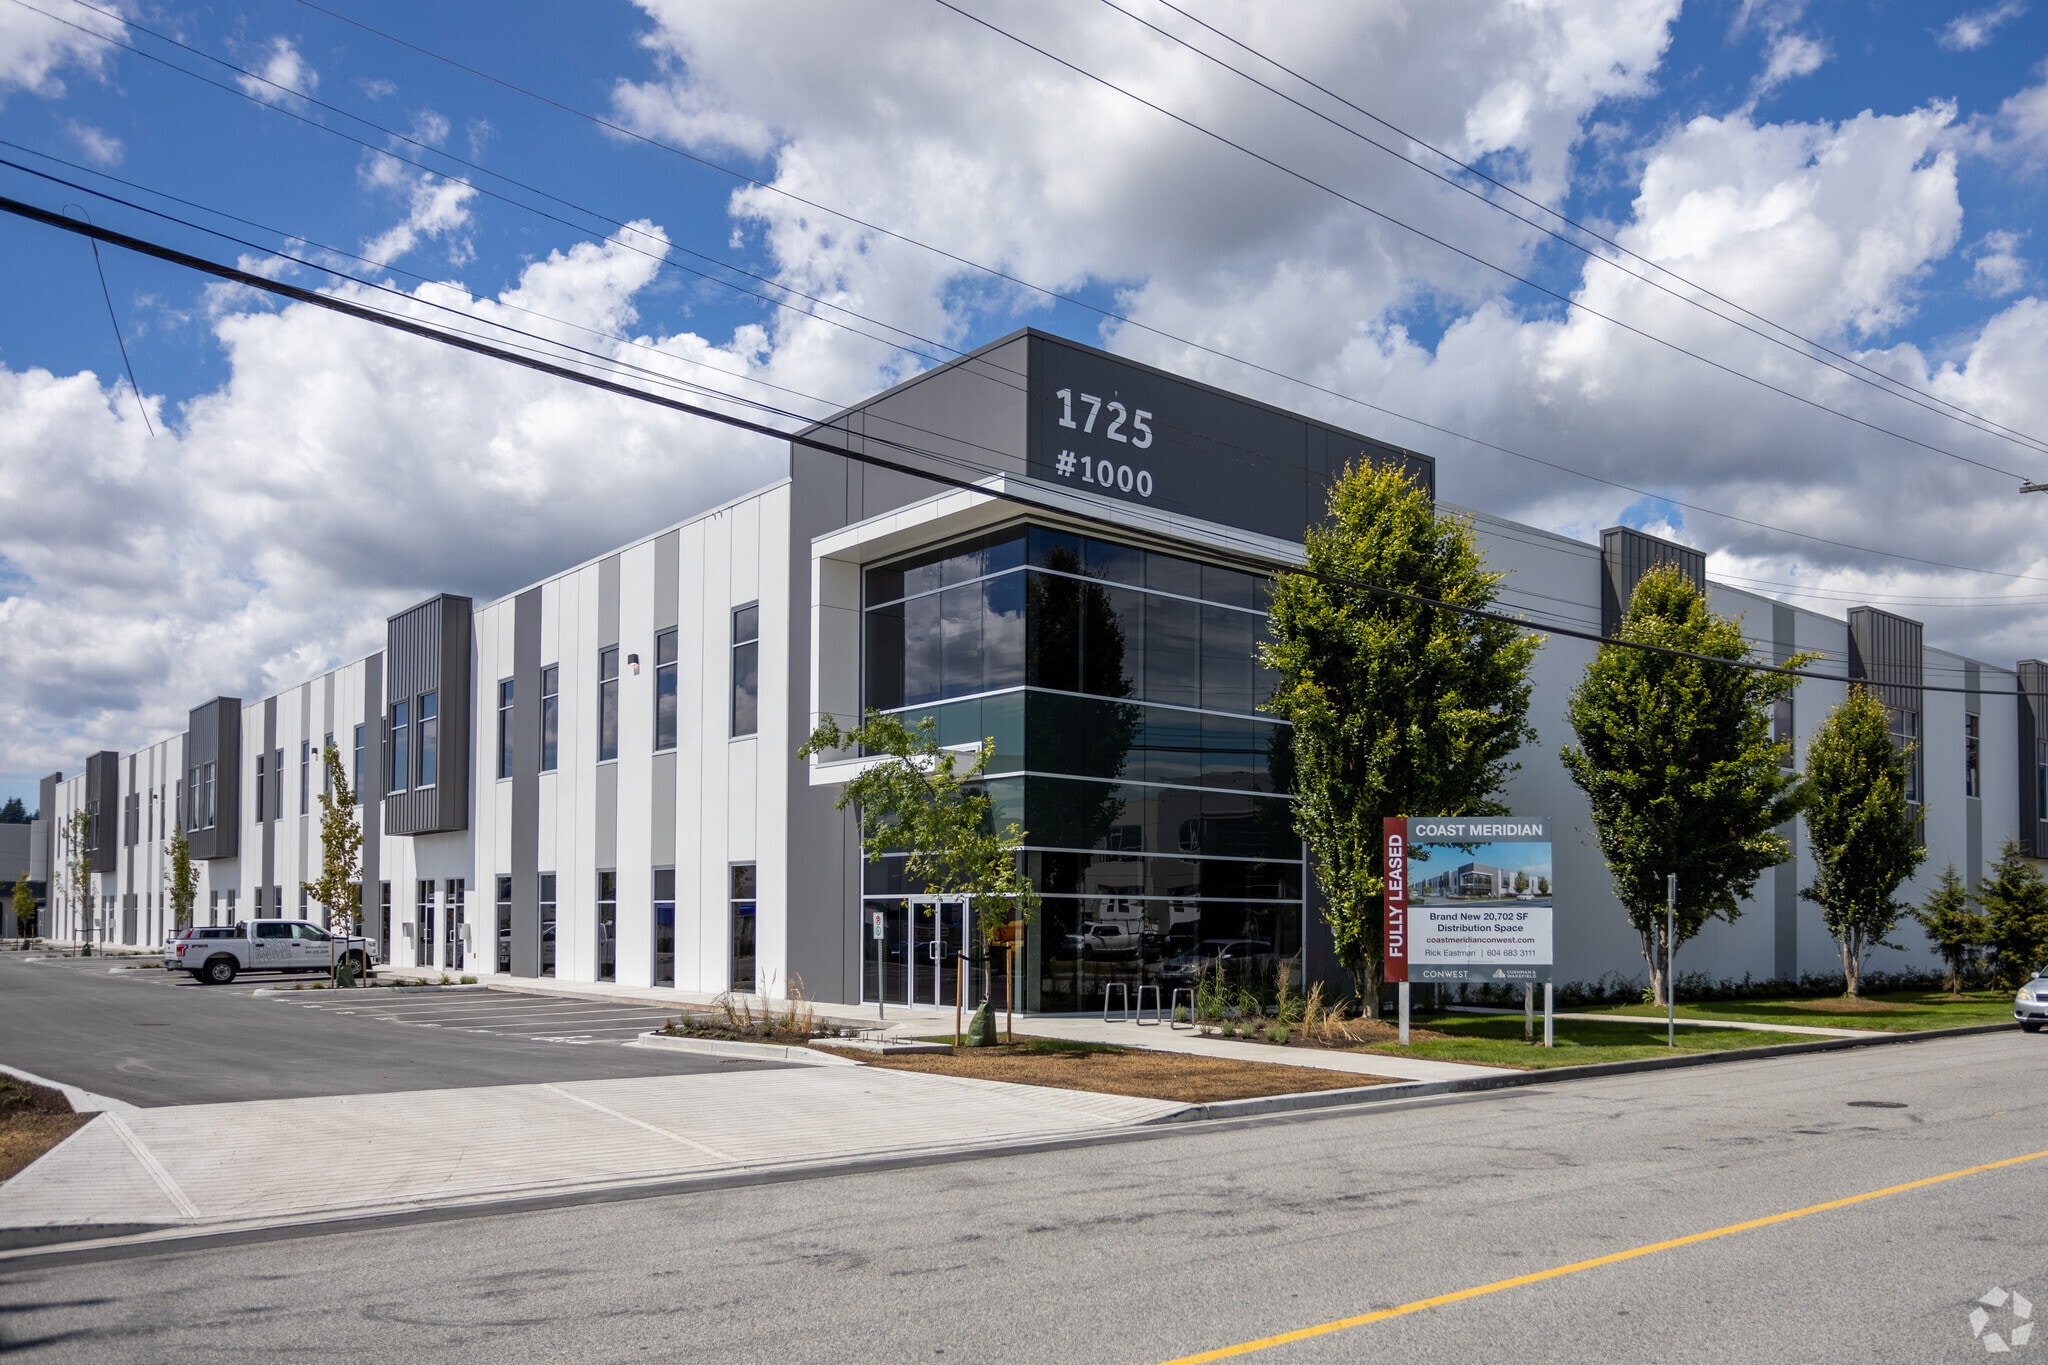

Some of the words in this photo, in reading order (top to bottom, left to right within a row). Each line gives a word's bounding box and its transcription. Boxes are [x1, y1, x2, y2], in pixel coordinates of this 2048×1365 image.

[1056, 388, 1153, 449] 1725
[1055, 449, 1153, 498] #1000
[1415, 824, 1466, 836] COAST
[1469, 824, 1543, 836] MERIDIAN
[1388, 834, 1403, 901] LEASED
[1429, 912, 1458, 921] Brand
[1460, 912, 1481, 921] New
[1483, 912, 1514, 921] 20,702
[1516, 912, 1529, 921] SF
[1388, 905, 1403, 957] FULLY
[1437, 923, 1492, 932] Distribution
[1493, 923, 1524, 933] Space
[1426, 936, 1535, 944] coastmeridianconwest.com
[1424, 949, 1442, 957] Rick
[1486, 949, 1501, 957] 604
[1503, 949, 1518, 957] 683
[1519, 949, 1536, 957] 3111
[1422, 970, 1469, 978] CONWEST
